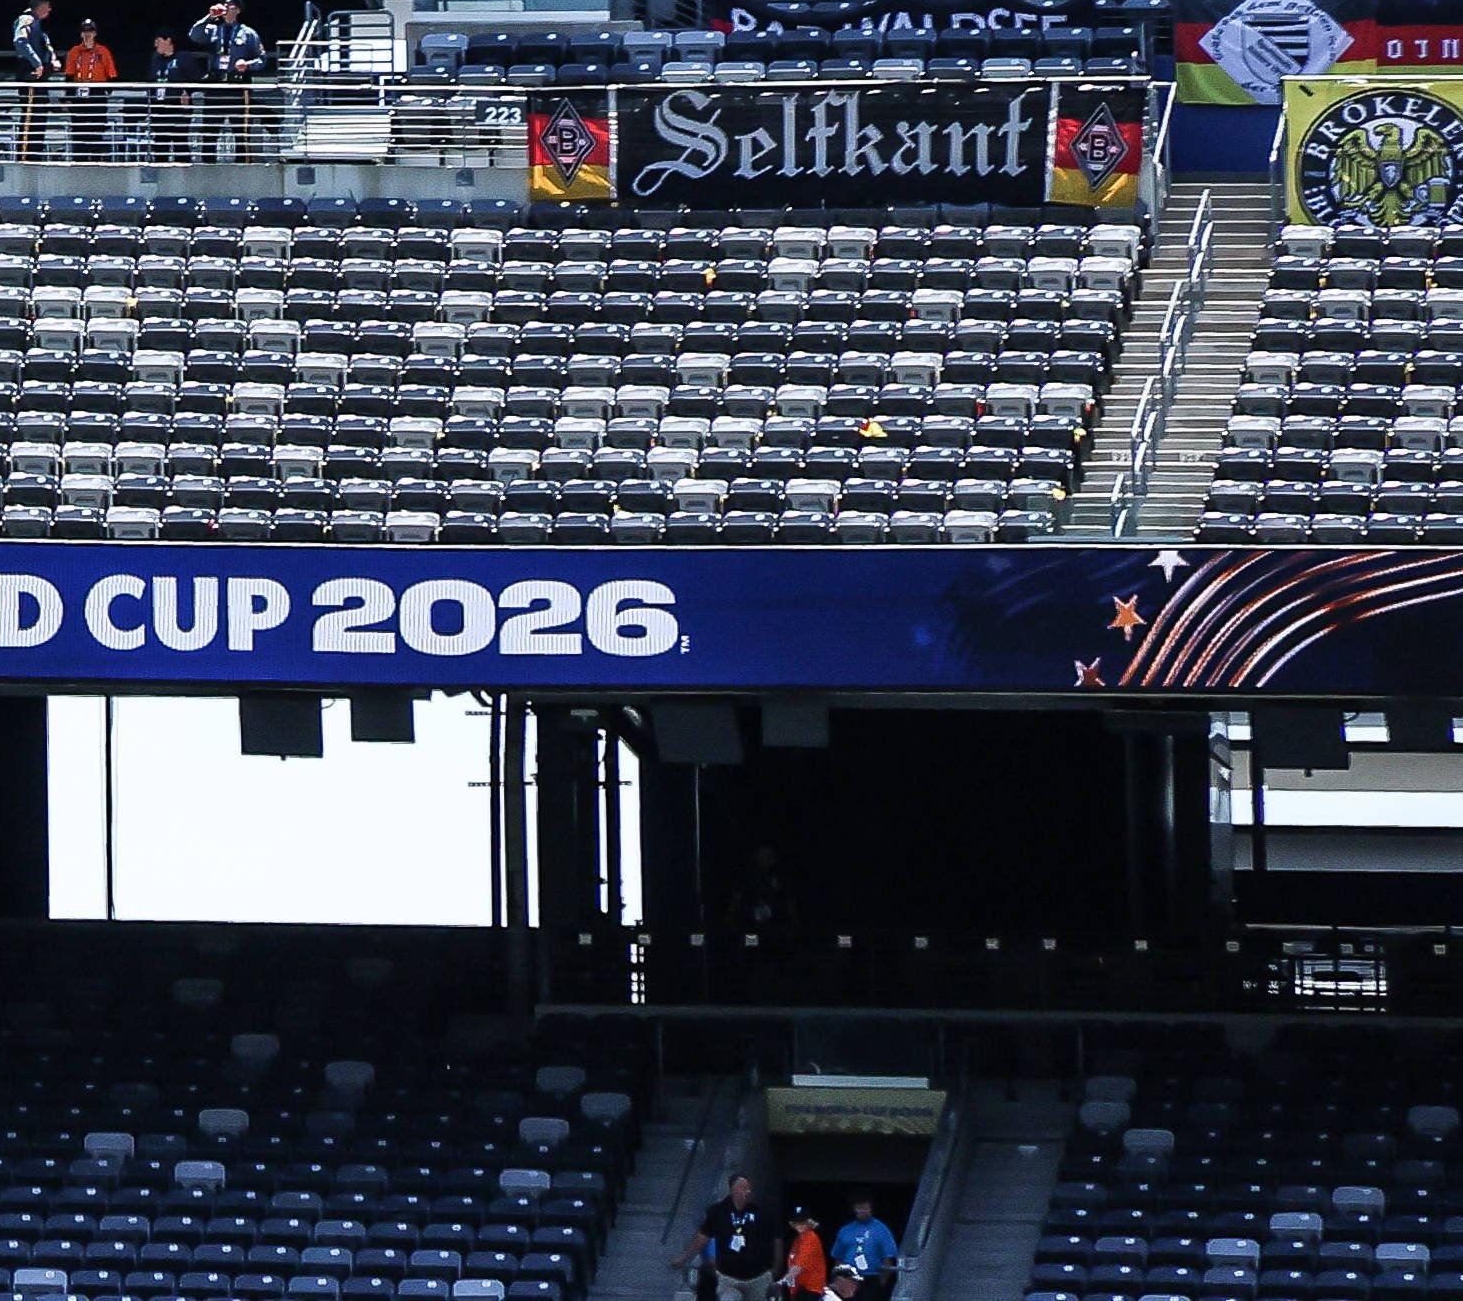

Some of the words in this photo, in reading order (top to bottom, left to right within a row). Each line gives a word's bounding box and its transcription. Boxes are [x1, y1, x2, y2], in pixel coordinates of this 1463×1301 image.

[483, 105, 522, 125] 223
[632, 90, 1033, 197] Selfkant
[85, 574, 274, 651] CUP
[312, 578, 681, 656] 2026
